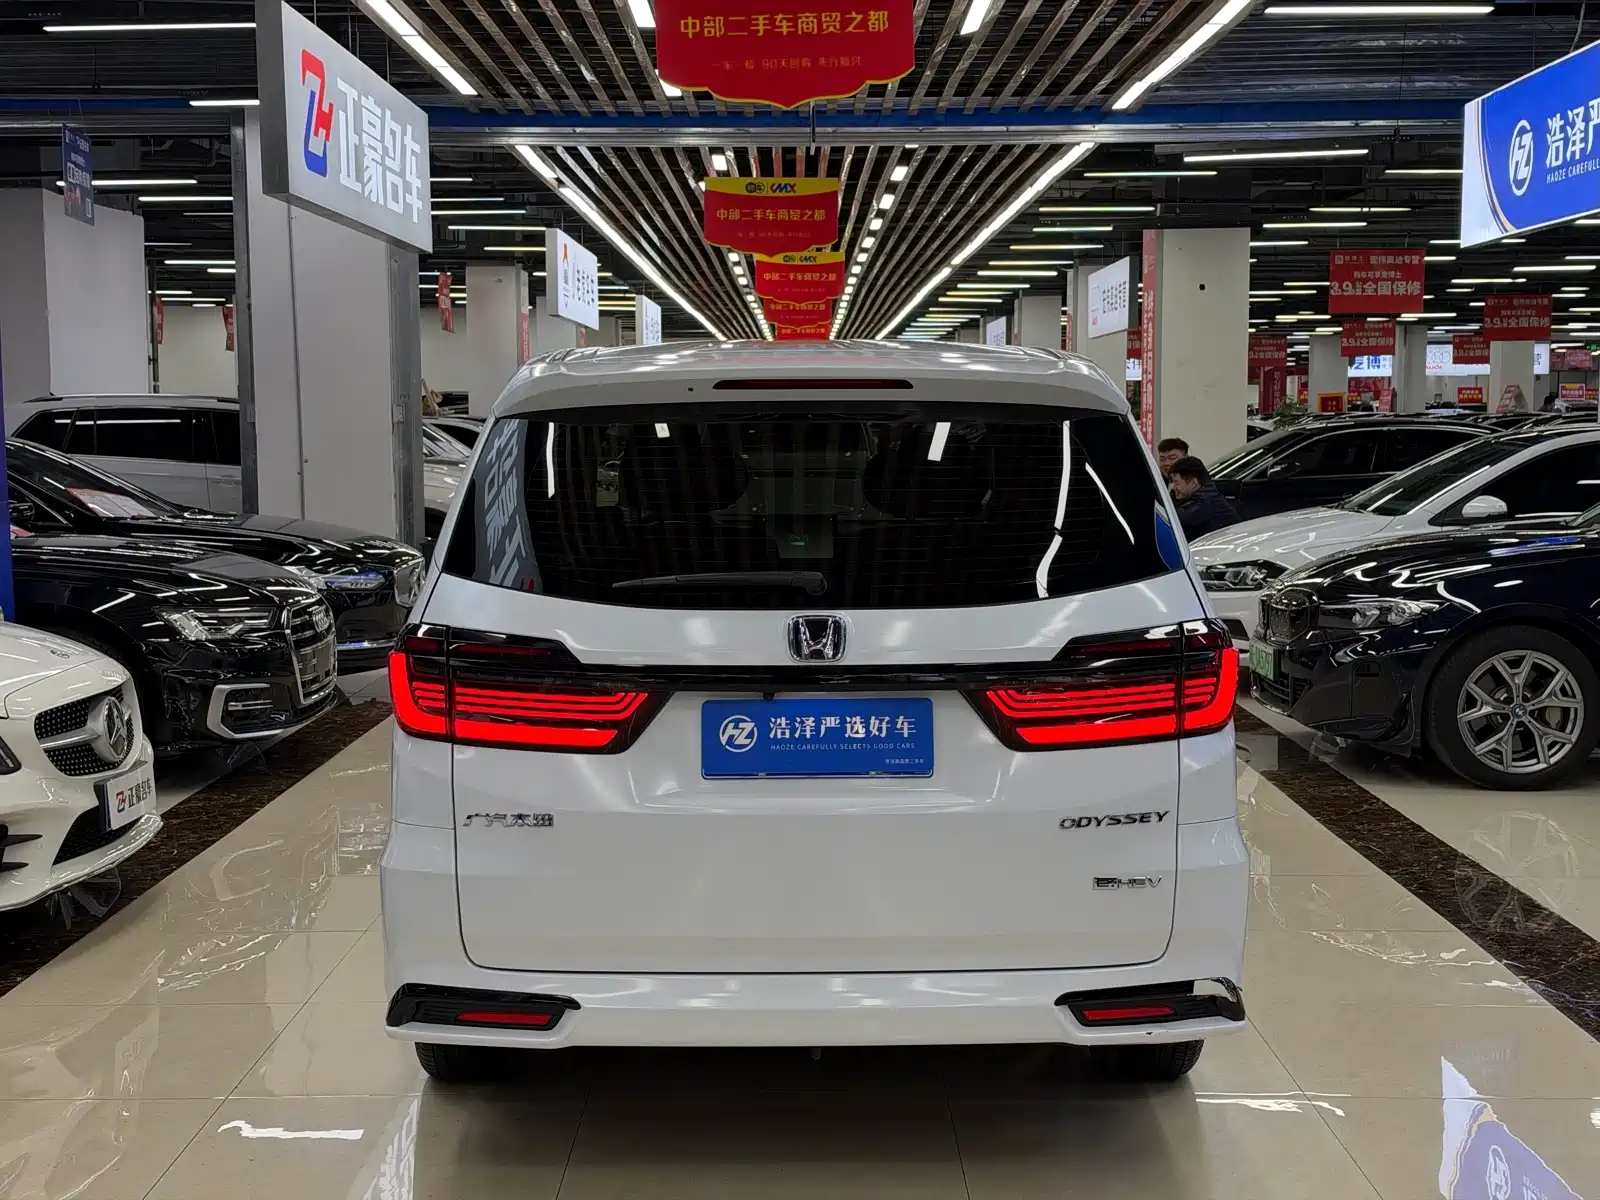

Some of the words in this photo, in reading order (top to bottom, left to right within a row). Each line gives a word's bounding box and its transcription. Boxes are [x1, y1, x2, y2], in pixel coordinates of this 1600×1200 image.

[680, 10, 889, 39] 中部二手车商贸之都
[336, 77, 422, 224] 正豪名车
[1546, 170, 1566, 184] HAOZE
[716, 208, 826, 221] 中部二手车商贸之都
[769, 715, 916, 739] 浩泽严选好车
[462, 812, 554, 828] 广汽本田
[1059, 810, 1170, 829] ODYSSEY
